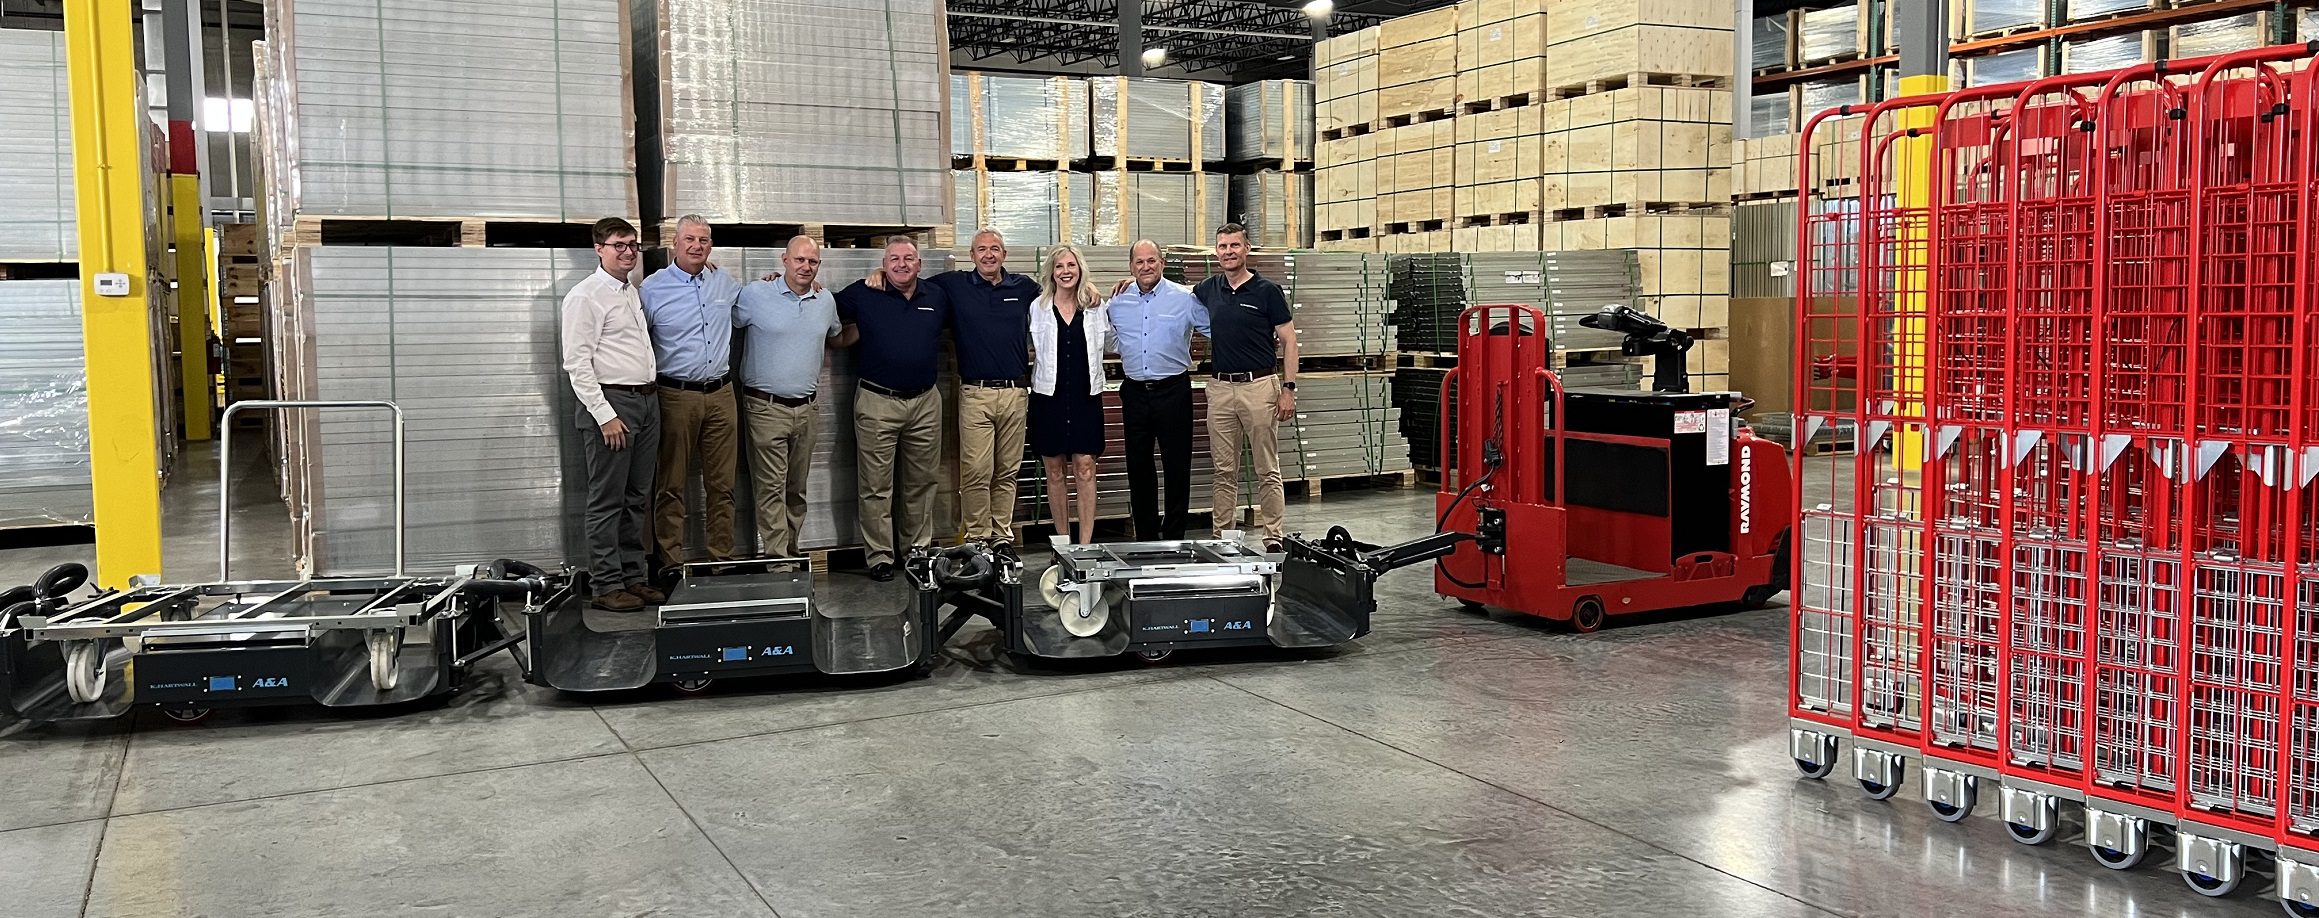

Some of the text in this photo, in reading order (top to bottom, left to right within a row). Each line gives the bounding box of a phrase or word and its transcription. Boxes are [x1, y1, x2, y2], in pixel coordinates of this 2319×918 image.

[1740, 445, 1751, 534] RAYMOND
[1223, 620, 1252, 630] A&A
[761, 645, 794, 656] A&A
[252, 677, 289, 688] A&A
